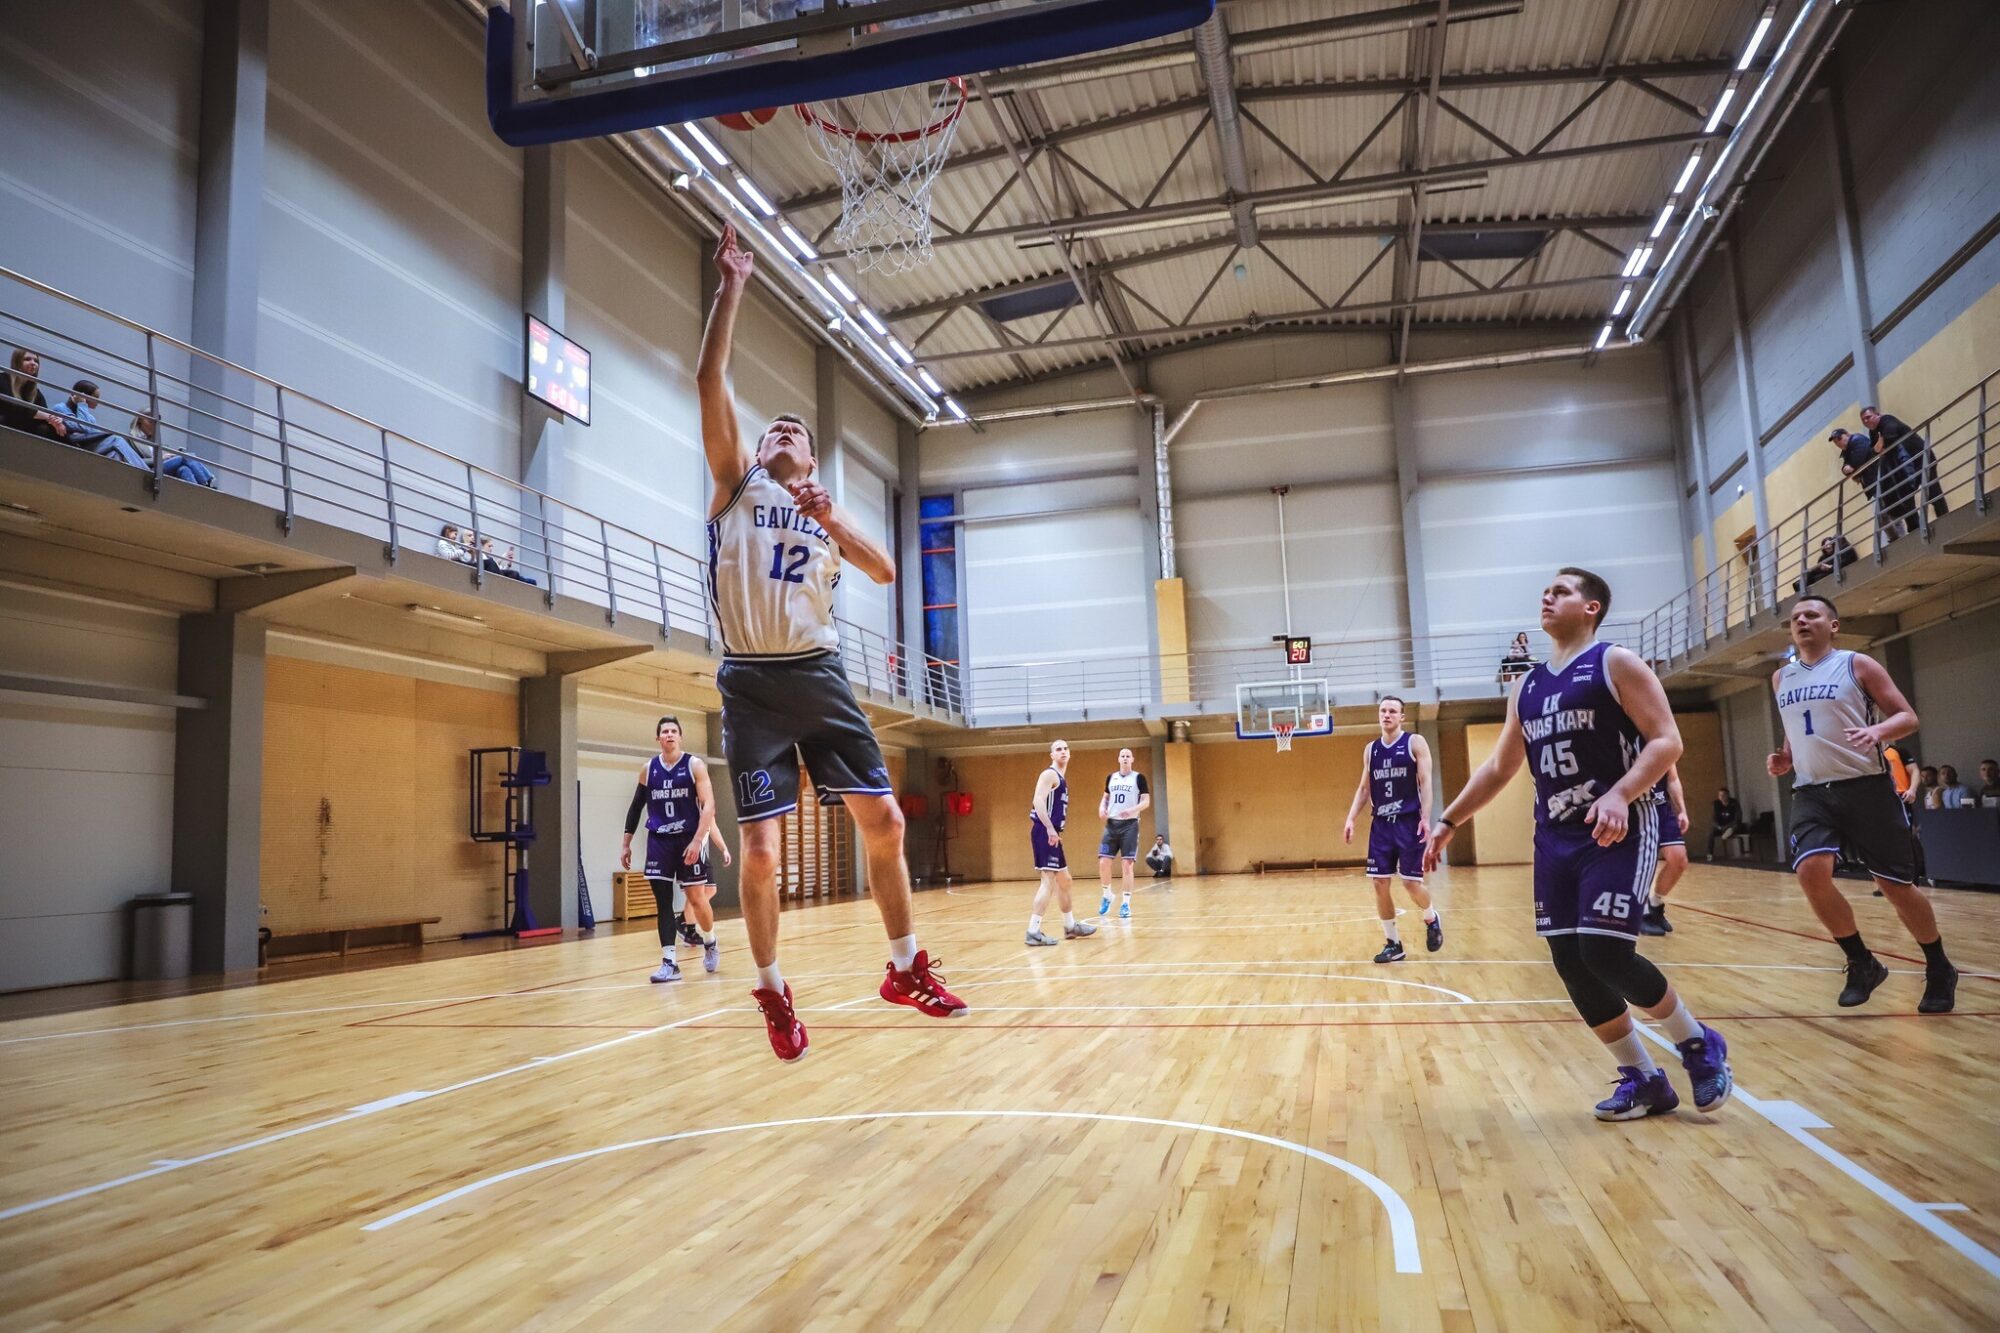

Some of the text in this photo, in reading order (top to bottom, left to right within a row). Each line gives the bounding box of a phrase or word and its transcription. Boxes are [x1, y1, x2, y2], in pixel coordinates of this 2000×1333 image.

[769, 542, 810, 583] 12
[1291, 648, 1307, 661] 20
[1542, 691, 1562, 717] LK
[1780, 684, 1839, 709] GAVIEZE
[1556, 709, 1595, 734] KAPI
[1803, 709, 1814, 736] 1
[1540, 739, 1579, 778] 45
[738, 769, 775, 807] 12
[1114, 793, 1126, 804] 10
[1385, 781, 1393, 797] 3
[665, 801, 675, 818] 0
[693, 864, 701, 876] 0
[1592, 891, 1632, 919] 45
